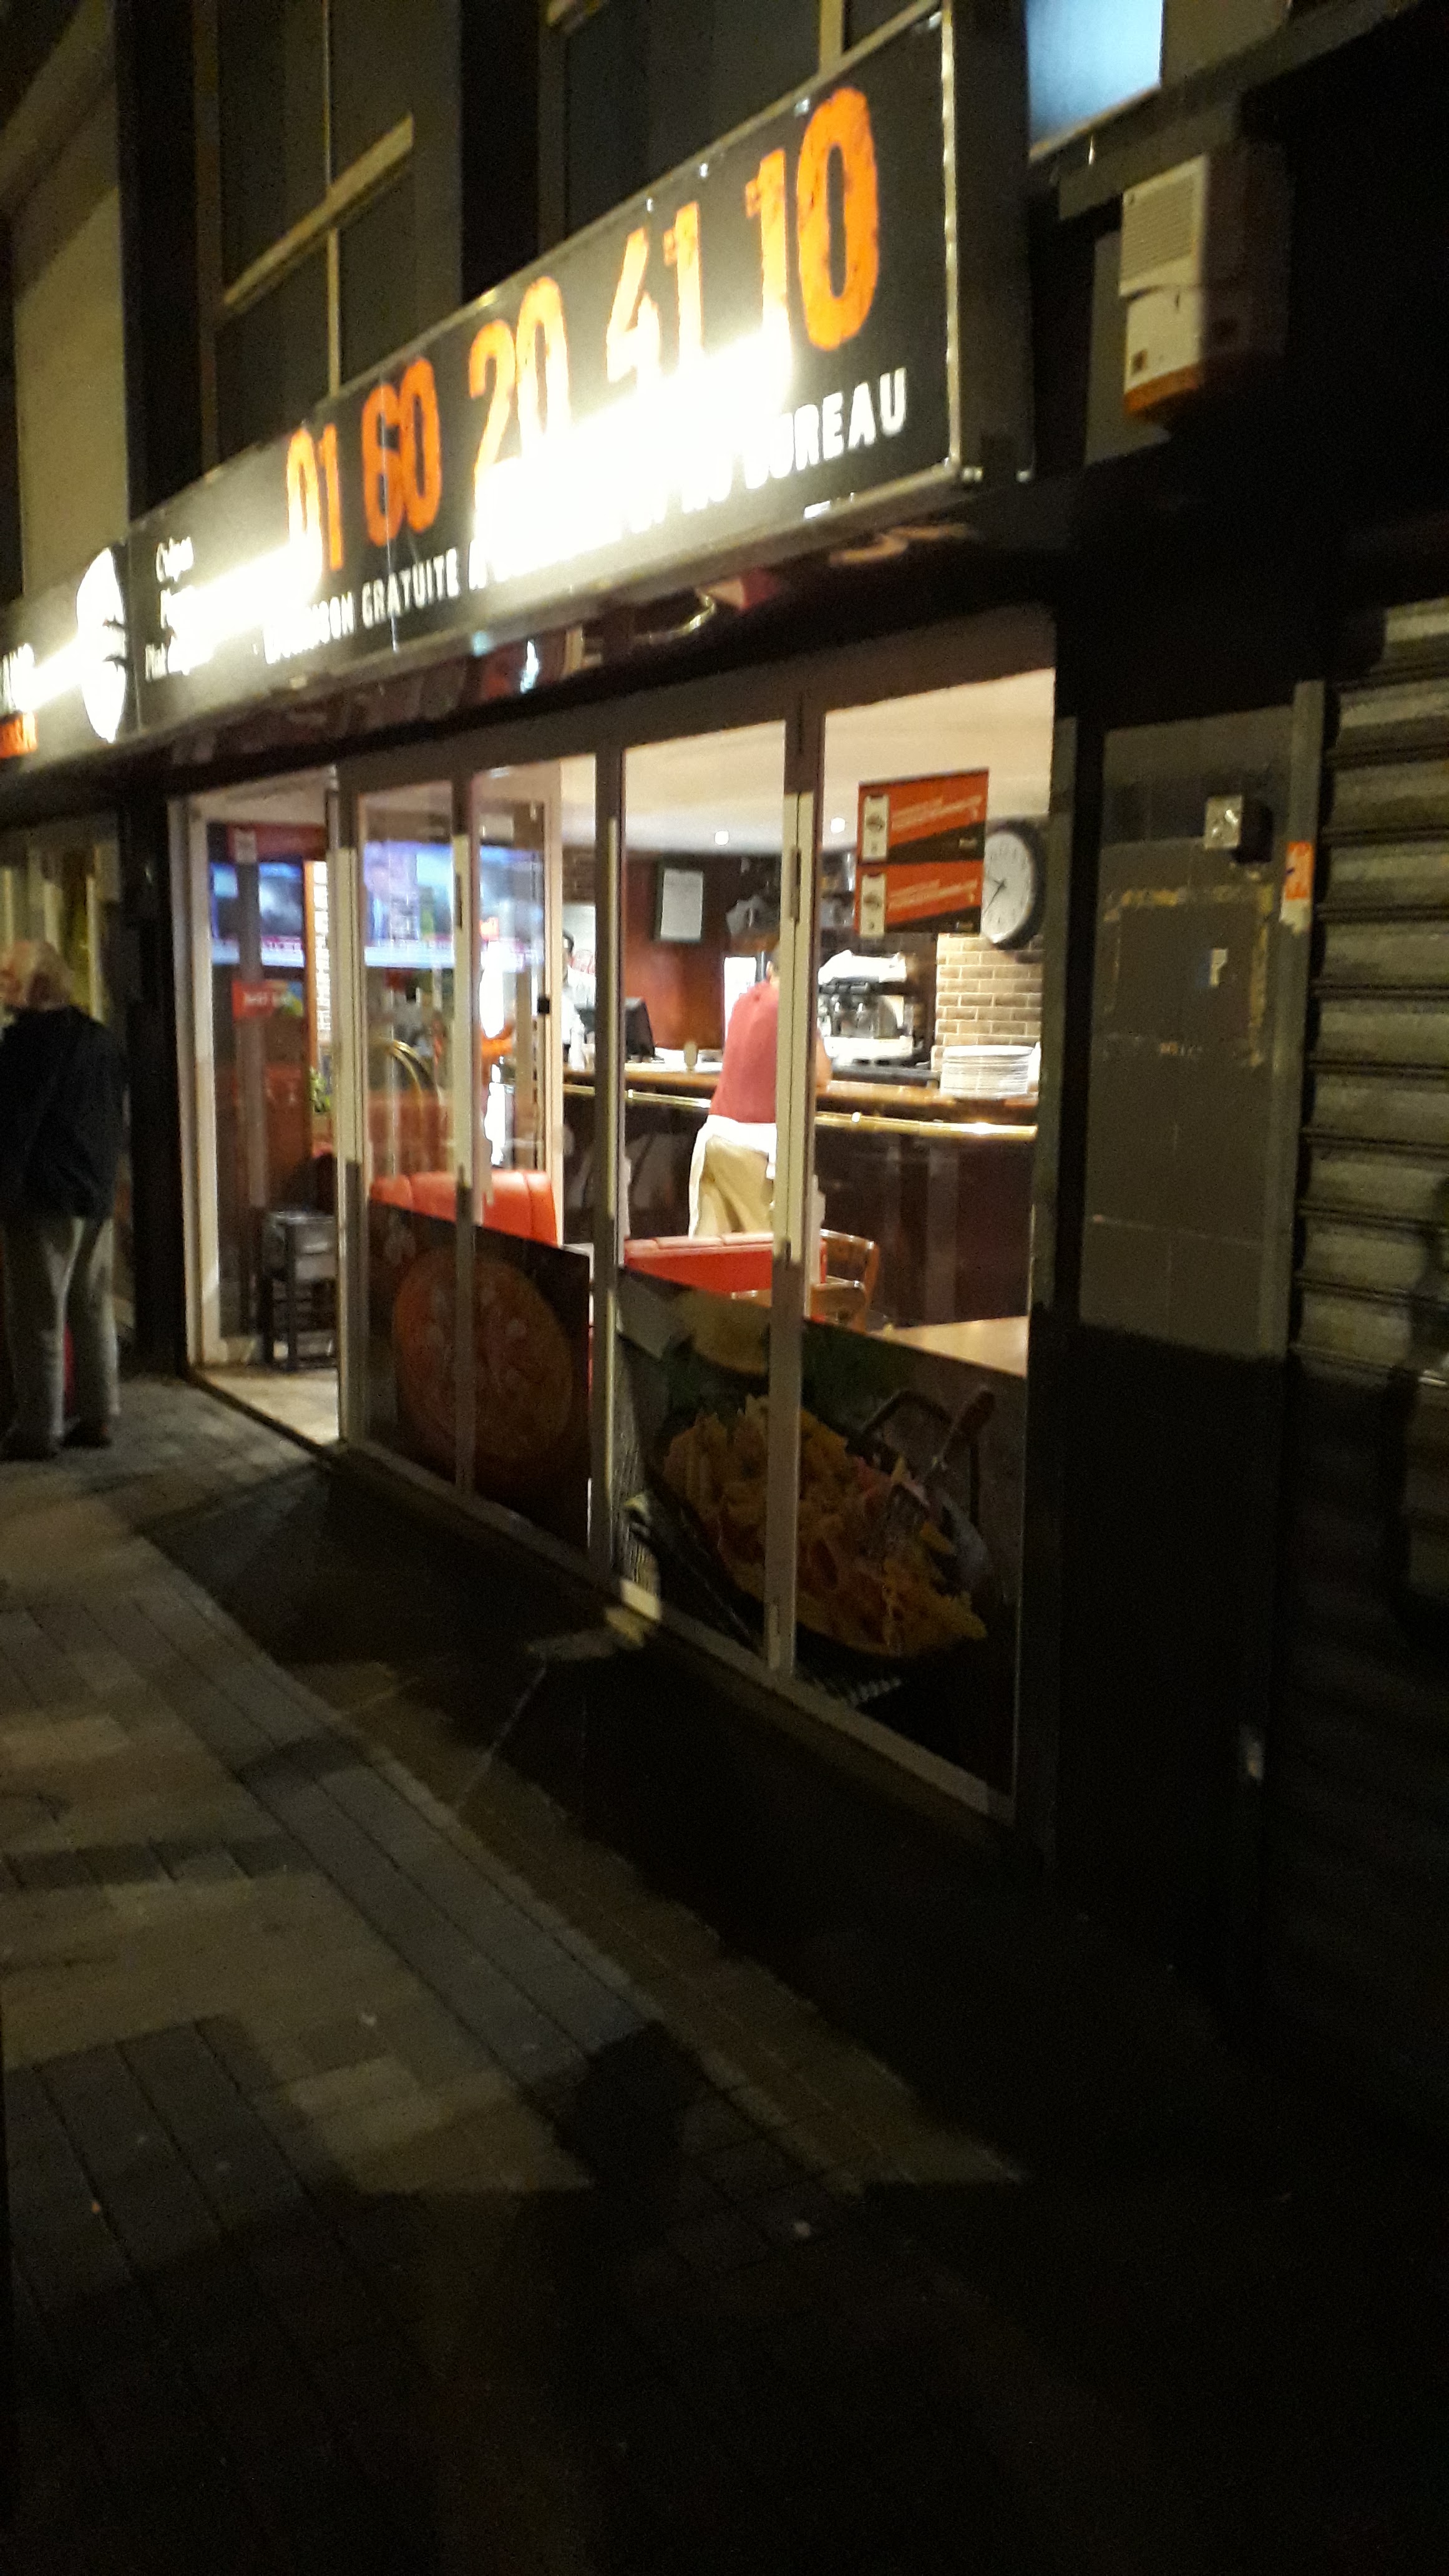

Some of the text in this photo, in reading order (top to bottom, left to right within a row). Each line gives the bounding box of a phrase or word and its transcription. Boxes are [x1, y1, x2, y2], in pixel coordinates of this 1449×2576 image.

[286, 423, 343, 580] 01
[361, 356, 441, 547] 60
[468, 276, 572, 527] 20
[605, 200, 704, 437] 41
[745, 86, 879, 399] 10
[362, 547, 461, 630] GRATUITE
